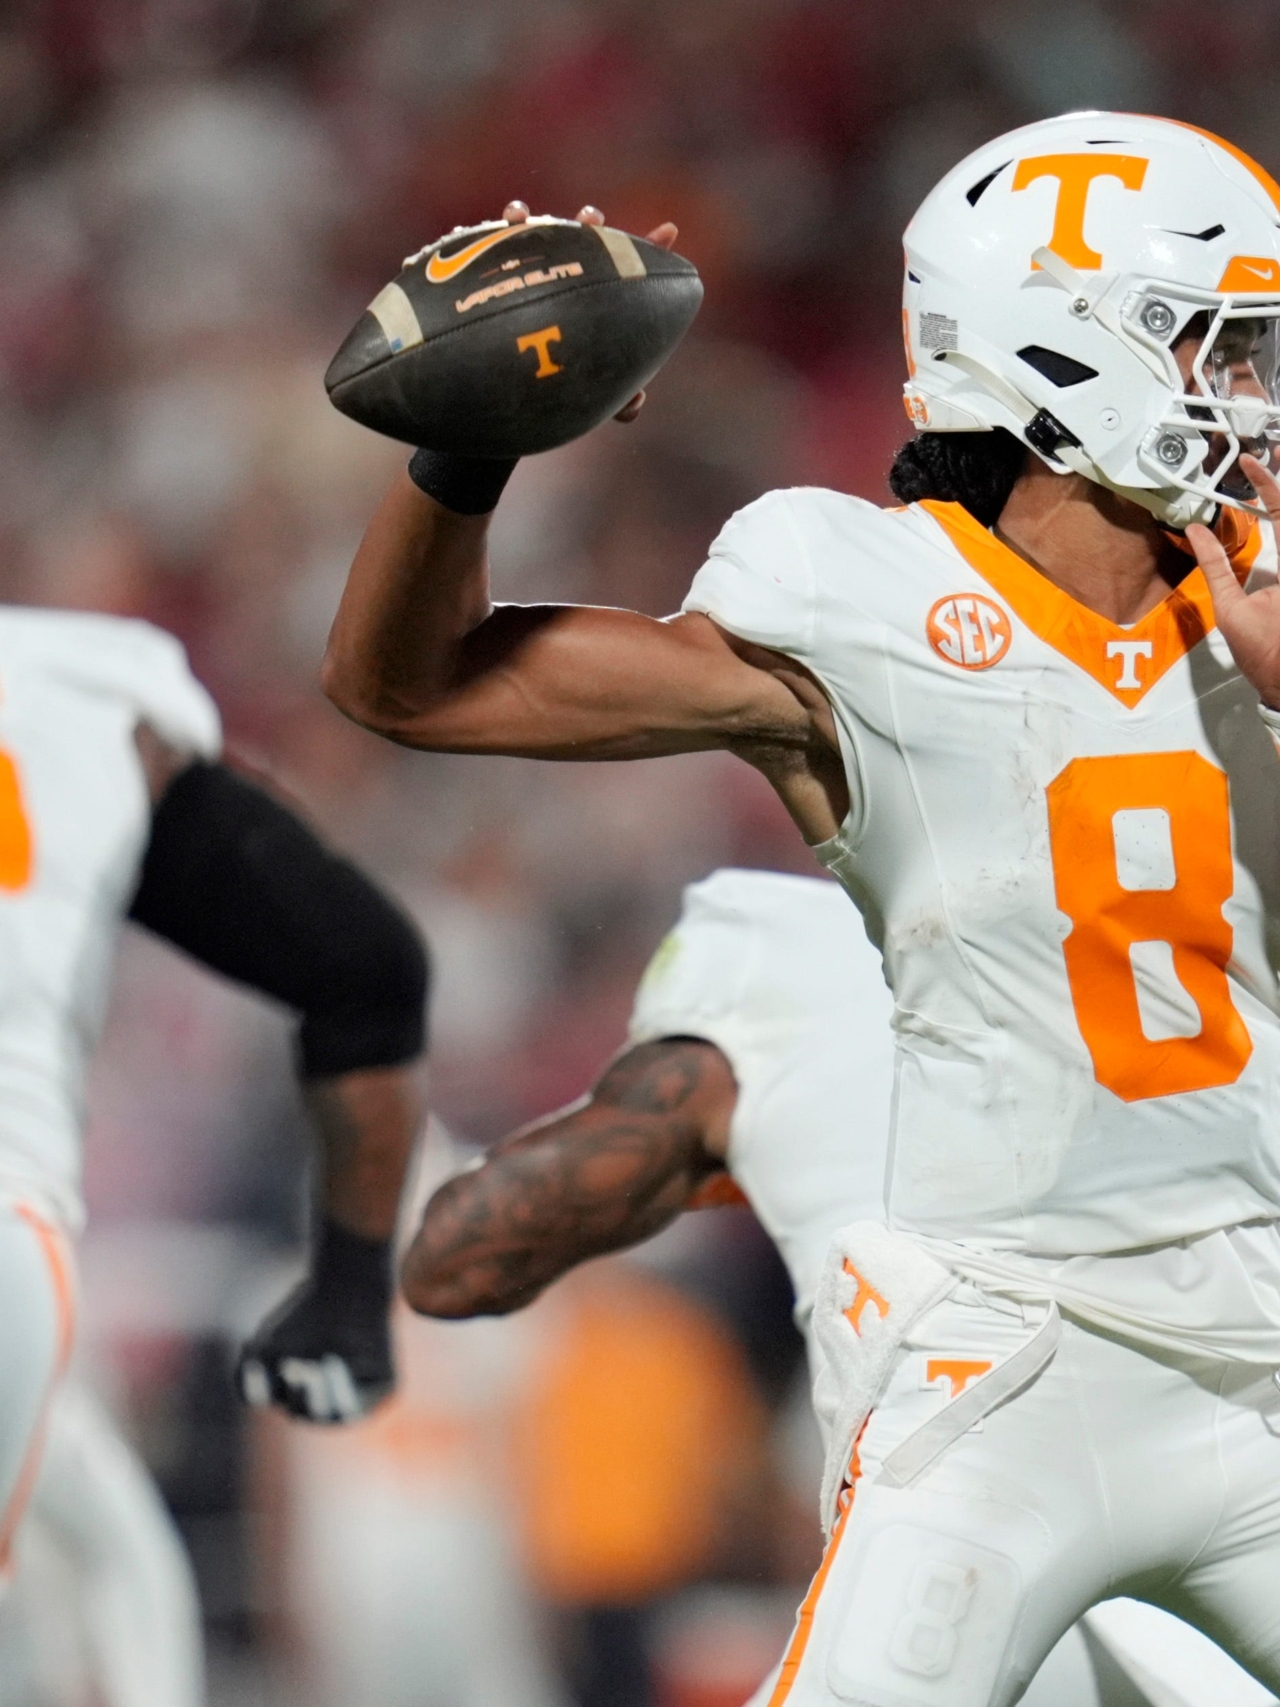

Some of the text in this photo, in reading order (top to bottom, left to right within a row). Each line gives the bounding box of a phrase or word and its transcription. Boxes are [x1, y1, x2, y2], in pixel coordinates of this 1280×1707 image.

[1011, 152, 1149, 271] T
[516, 325, 564, 379] T
[935, 597, 1006, 666] SEC
[1106, 641, 1153, 689] T
[1045, 749, 1254, 1104] 8
[842, 1256, 890, 1339] T
[888, 1559, 978, 1681] 8
